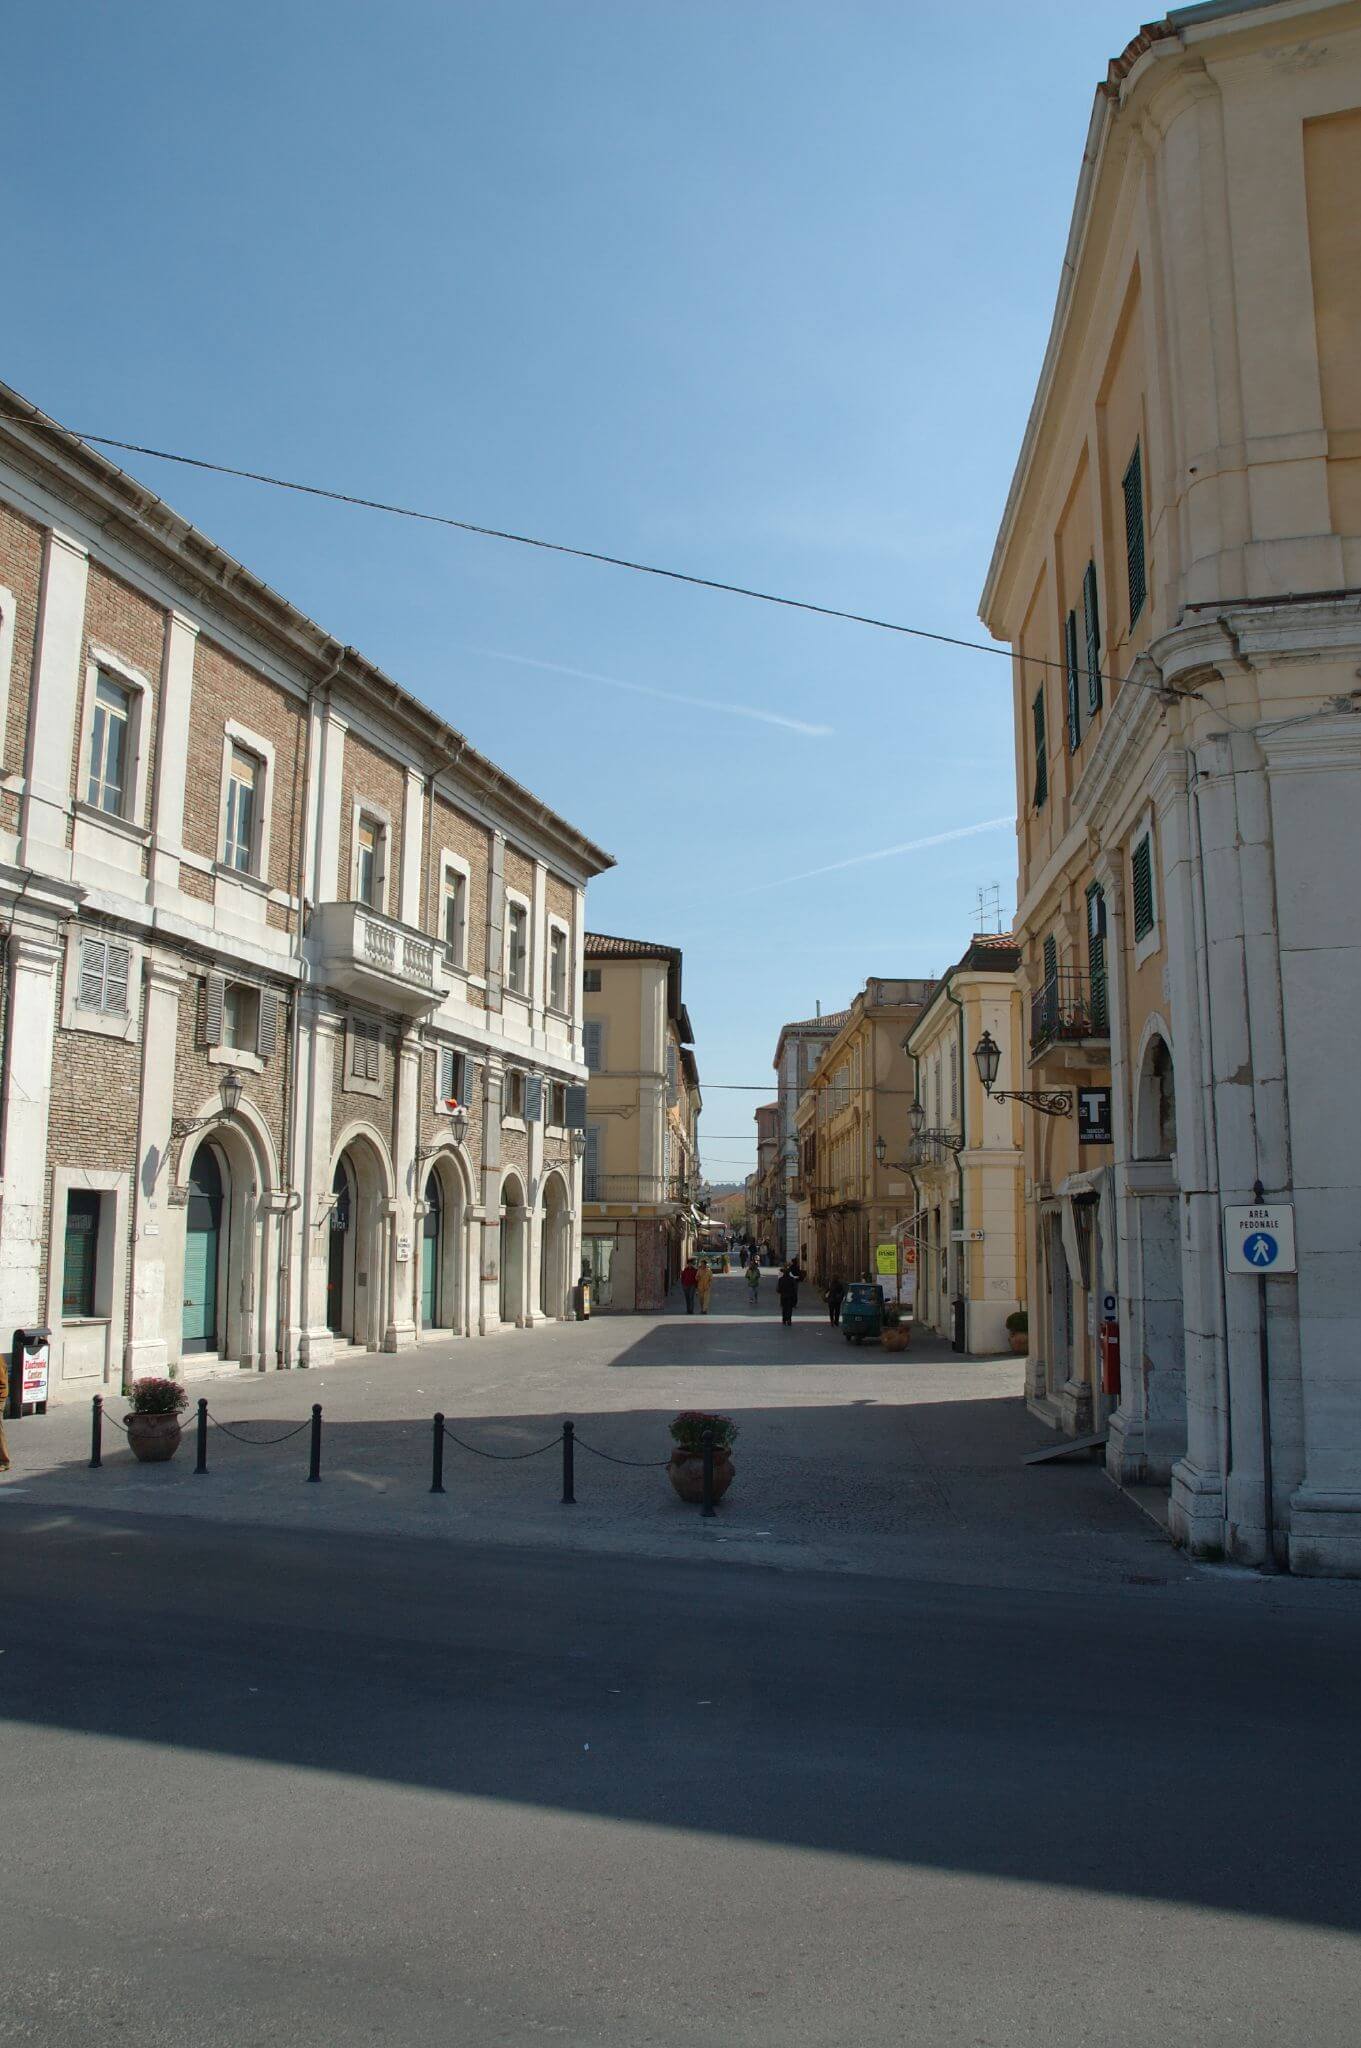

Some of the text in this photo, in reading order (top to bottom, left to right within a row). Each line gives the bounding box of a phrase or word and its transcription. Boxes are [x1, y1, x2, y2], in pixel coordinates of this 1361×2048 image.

[1081, 1093, 1106, 1122] T
[1248, 1210, 1269, 1218] AREA
[1240, 1220, 1280, 1229] PEDONALE
